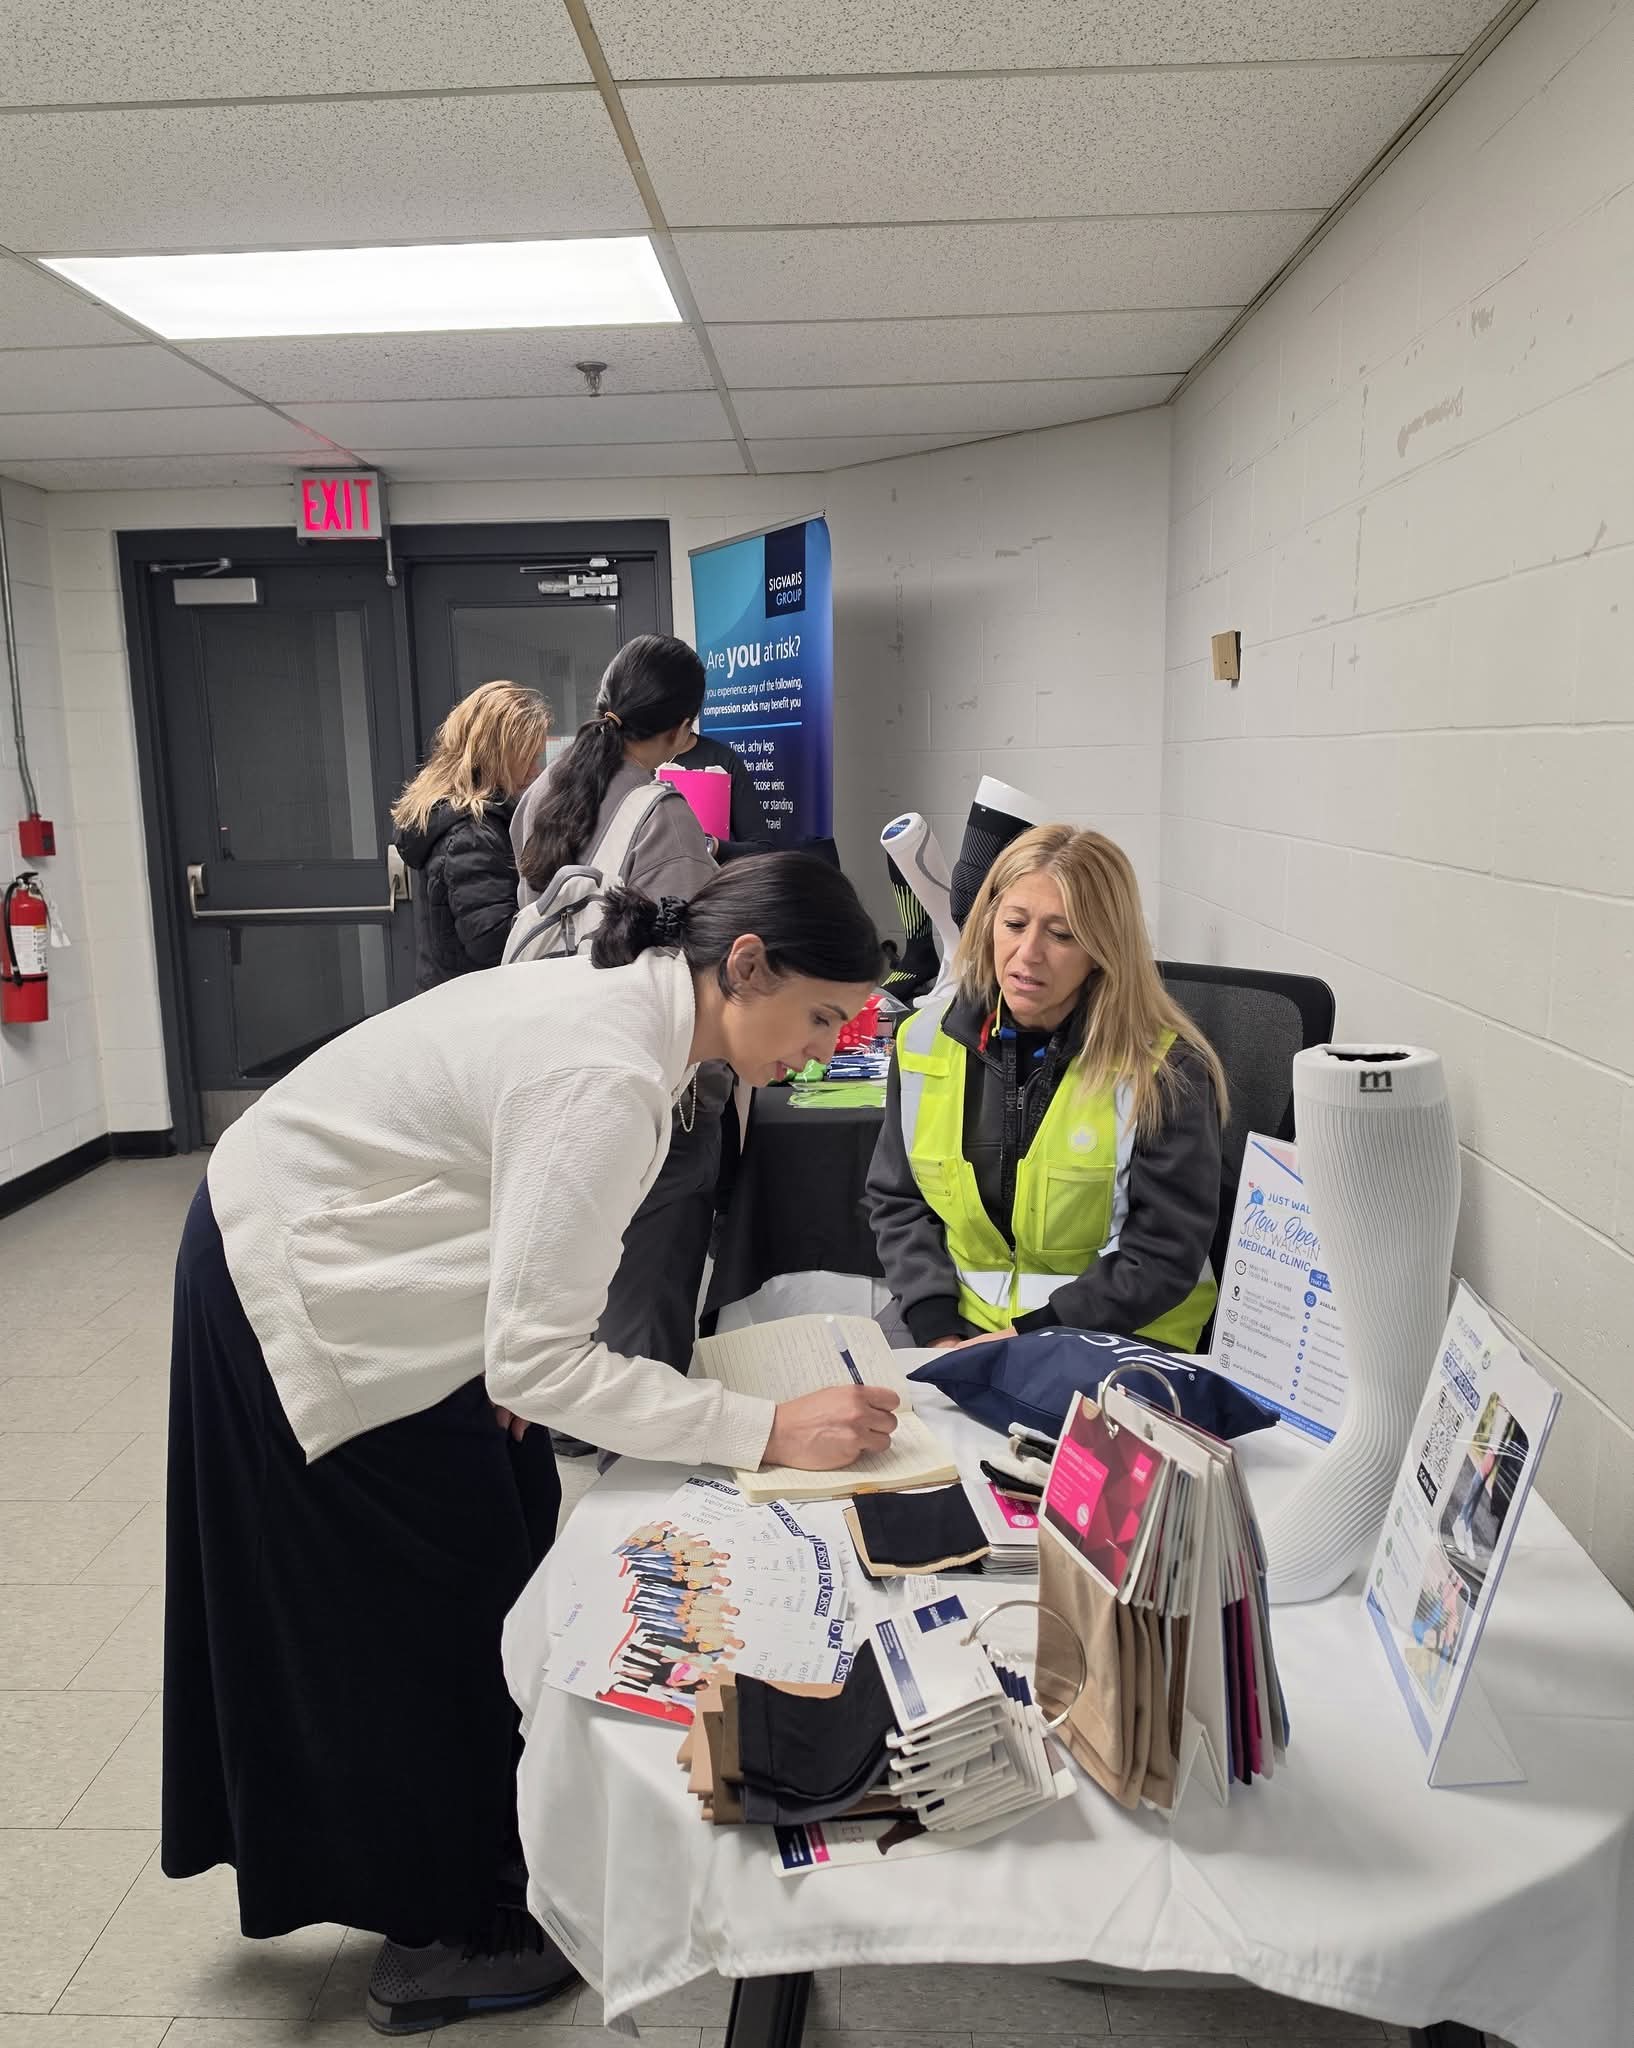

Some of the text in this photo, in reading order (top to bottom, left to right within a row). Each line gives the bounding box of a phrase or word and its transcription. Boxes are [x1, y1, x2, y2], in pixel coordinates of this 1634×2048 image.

[302, 479, 372, 531] EXIT
[768, 571, 803, 592] SIGVARIS
[776, 588, 802, 606] GROUP
[706, 634, 801, 679] Are you at risk?
[706, 688, 717, 700] you
[717, 684, 747, 699] experience
[748, 683, 759, 696] any
[759, 679, 766, 693] of
[766, 679, 775, 691] the
[703, 696, 801, 717] compression socks may benefit you
[747, 739, 762, 755] achy
[762, 739, 775, 755] legs
[755, 758, 774, 772] ankles
[771, 778, 785, 791] veins
[762, 797, 794, 814] or standing
[1267, 1192, 1289, 1207] JUST
[1238, 1237, 1312, 1272] MEDICAL CLINIC
[815, 1544, 830, 1569] JOBST
[816, 1589, 832, 1616] JOBST
[833, 1654, 853, 1683] JOBST
